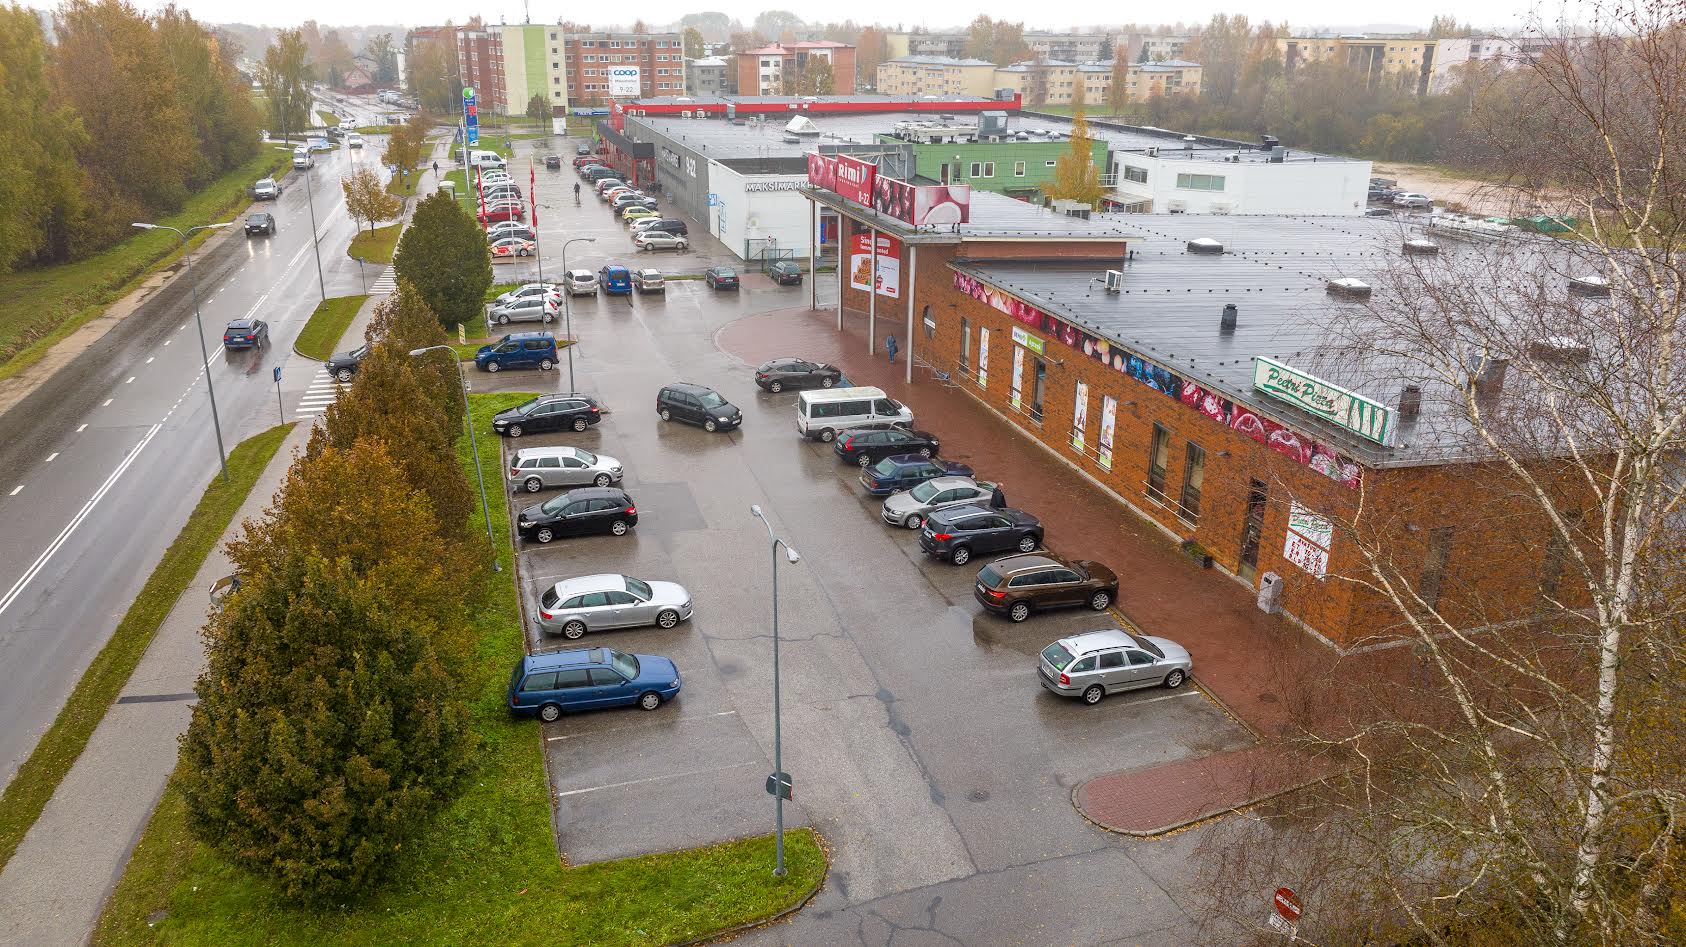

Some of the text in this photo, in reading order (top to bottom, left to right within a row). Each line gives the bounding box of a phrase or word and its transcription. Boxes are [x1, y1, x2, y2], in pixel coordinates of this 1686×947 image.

[613, 69, 637, 77] coop
[838, 162, 860, 184] Rimi
[858, 190, 870, 206] 8-22
[1268, 367, 1336, 409] Peetri Pizza
